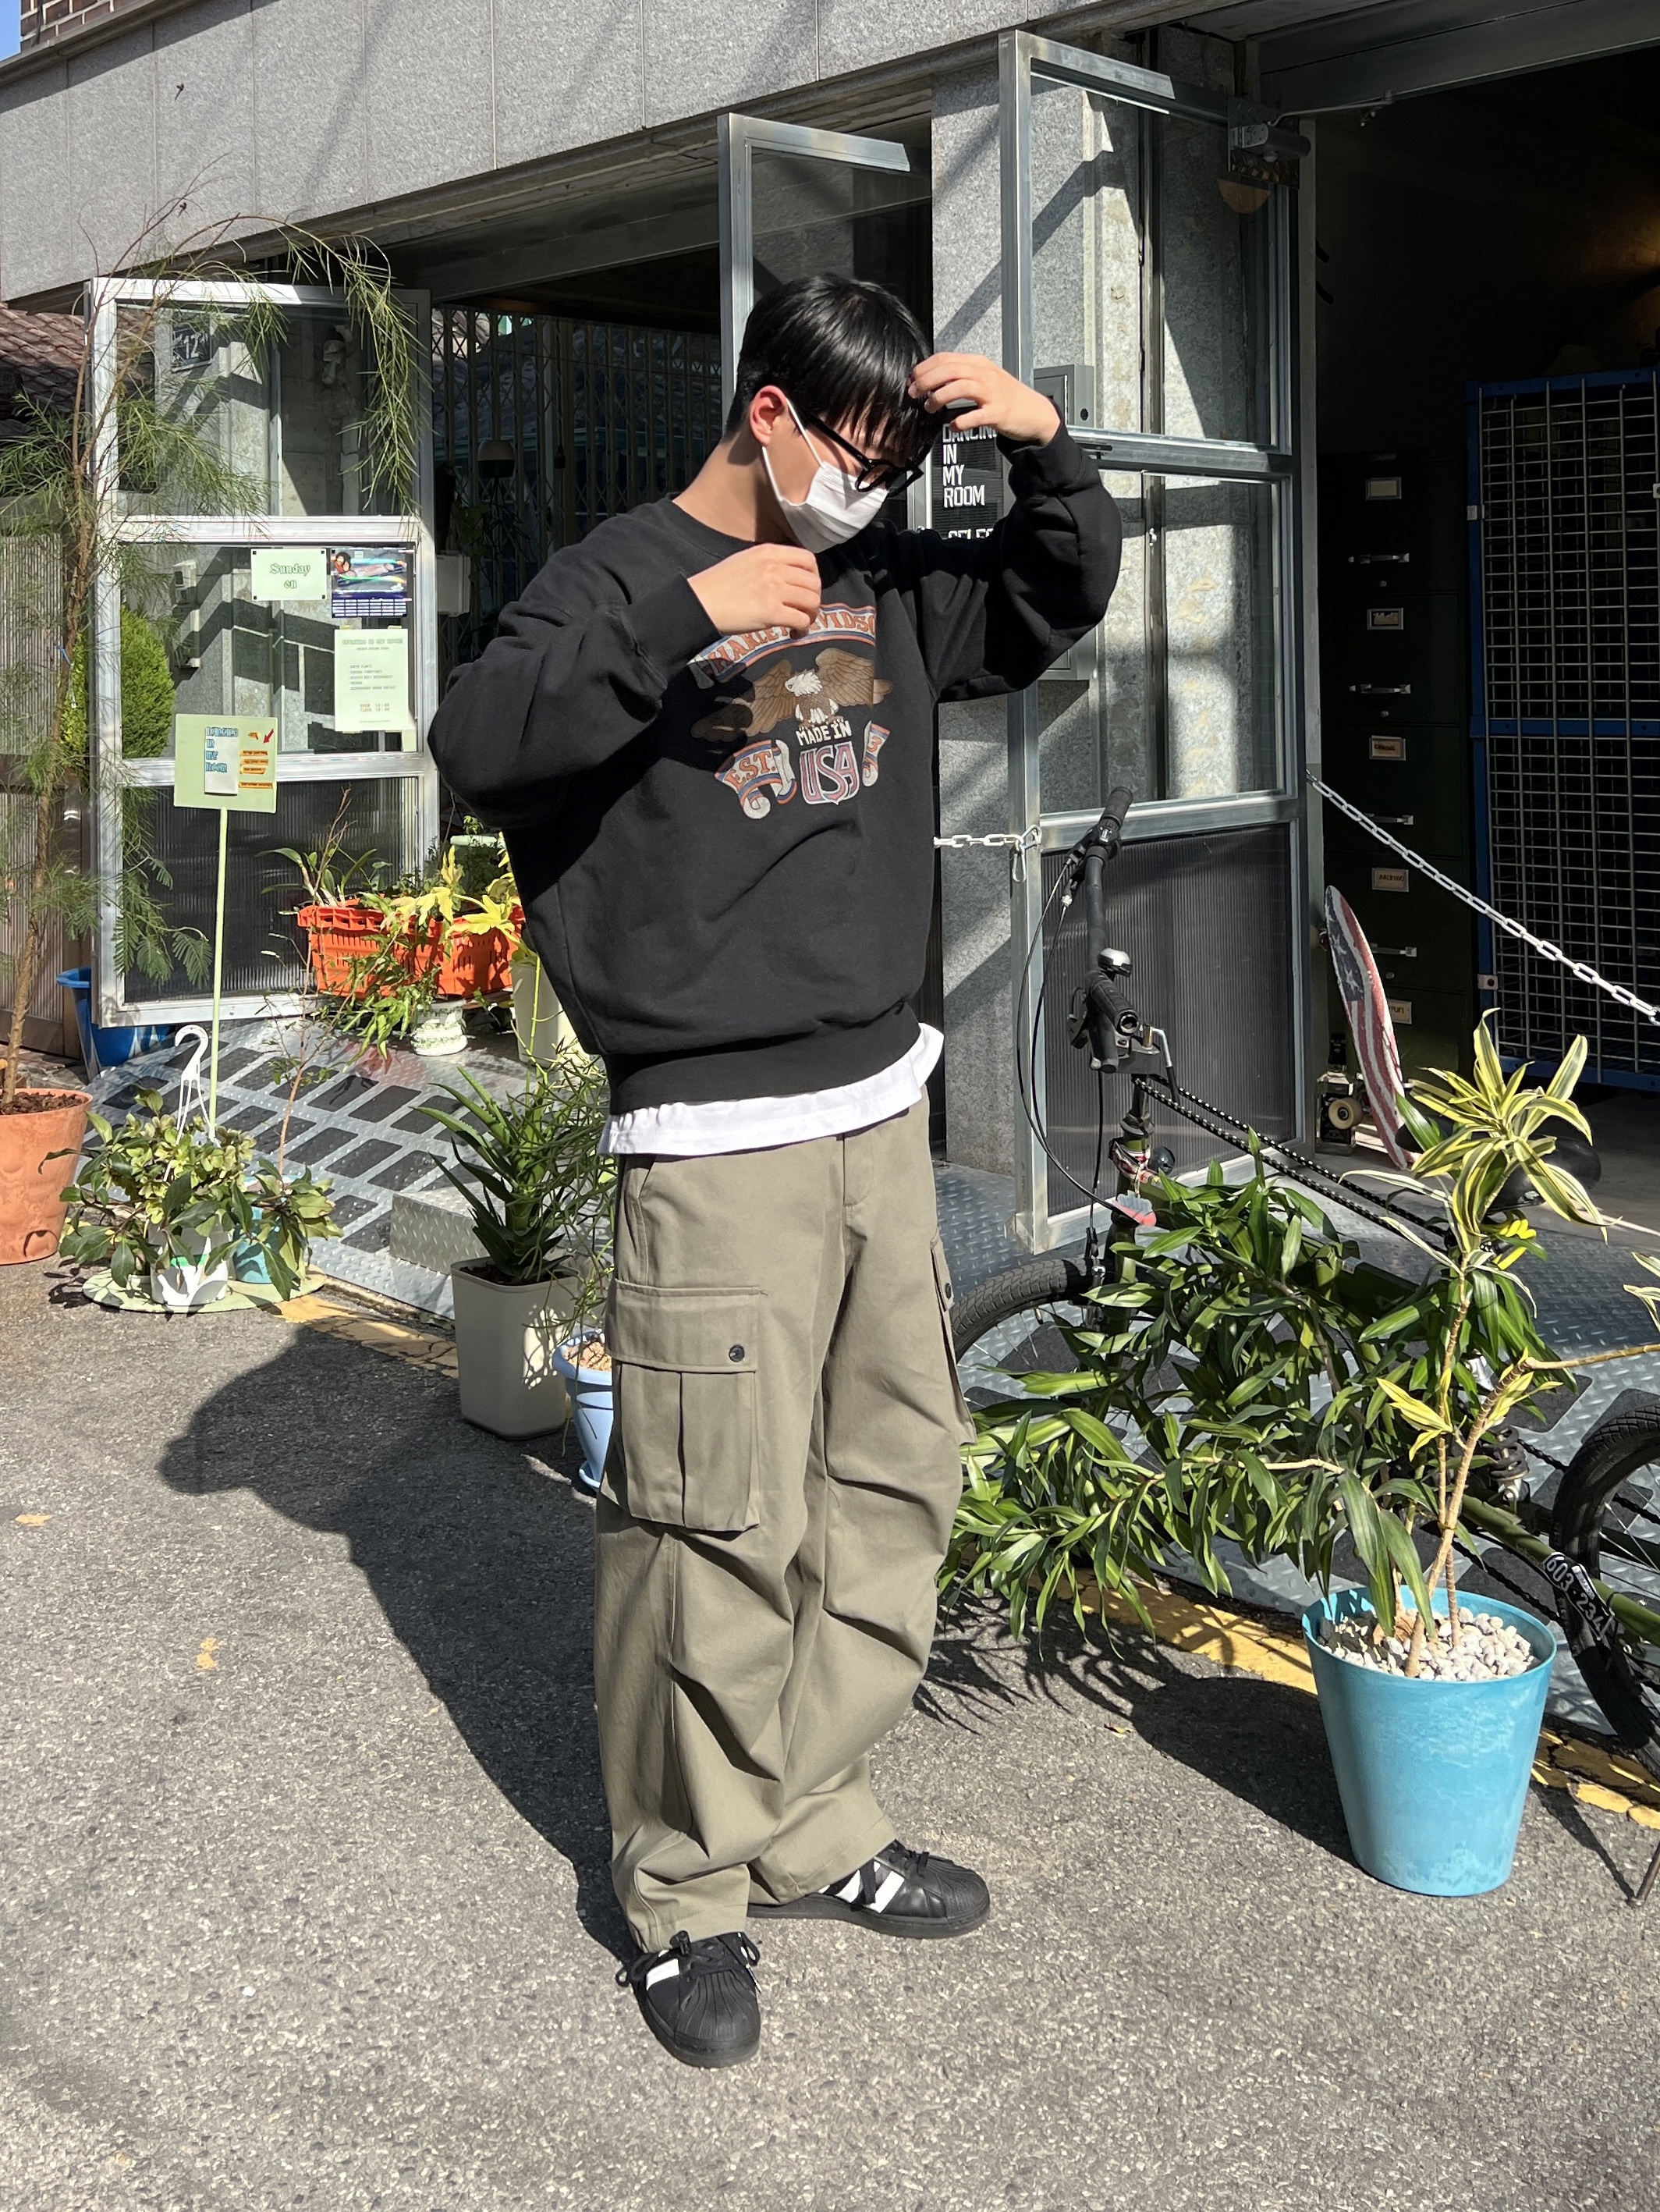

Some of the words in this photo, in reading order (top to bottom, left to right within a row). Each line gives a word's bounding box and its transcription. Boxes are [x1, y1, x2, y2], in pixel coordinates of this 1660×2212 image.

[943, 444, 957, 464] IN
[942, 464, 964, 486] MY
[943, 485, 985, 508] ROOM
[270, 563, 310, 577] Sunday
[795, 725, 832, 746] MADE
[832, 720, 852, 739] IN
[724, 750, 776, 790] EST.
[799, 740, 860, 805] USA
